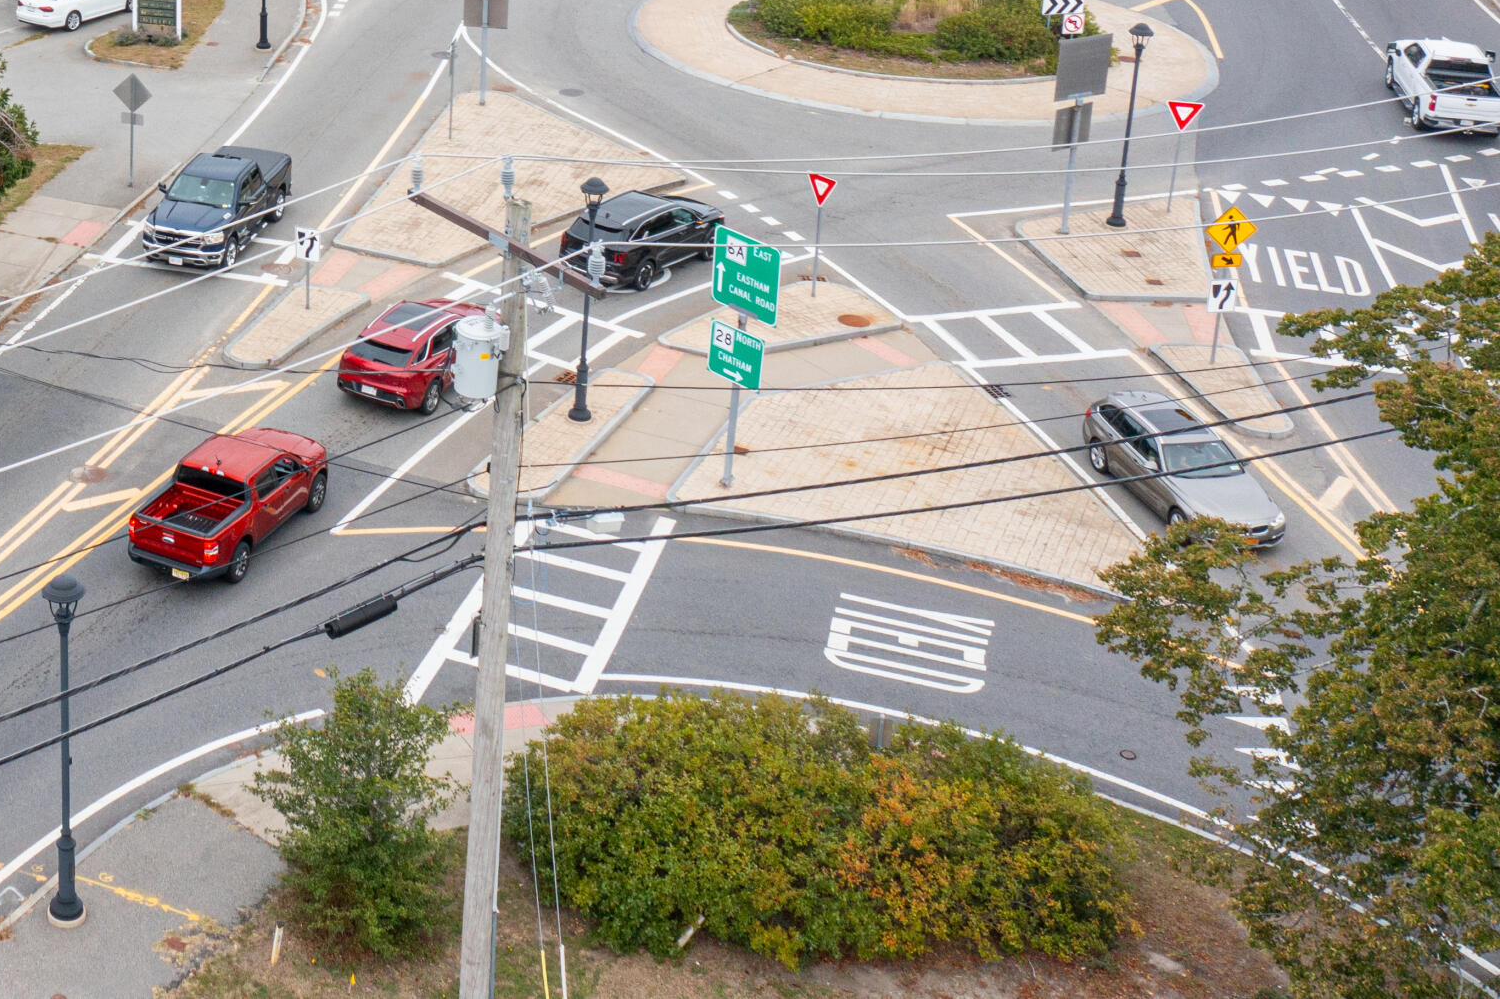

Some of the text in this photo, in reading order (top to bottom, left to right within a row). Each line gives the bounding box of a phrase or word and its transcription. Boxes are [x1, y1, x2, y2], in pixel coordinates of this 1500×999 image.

[753, 247, 772, 262] EAST
[1237, 243, 1371, 297] YIELD
[736, 272, 770, 294] EASTHAM
[728, 284, 775, 313] CANAL ROAD
[715, 328, 761, 351] 28 NORTH
[718, 352, 752, 373] CHATHAM
[823, 592, 995, 694] YIELD
